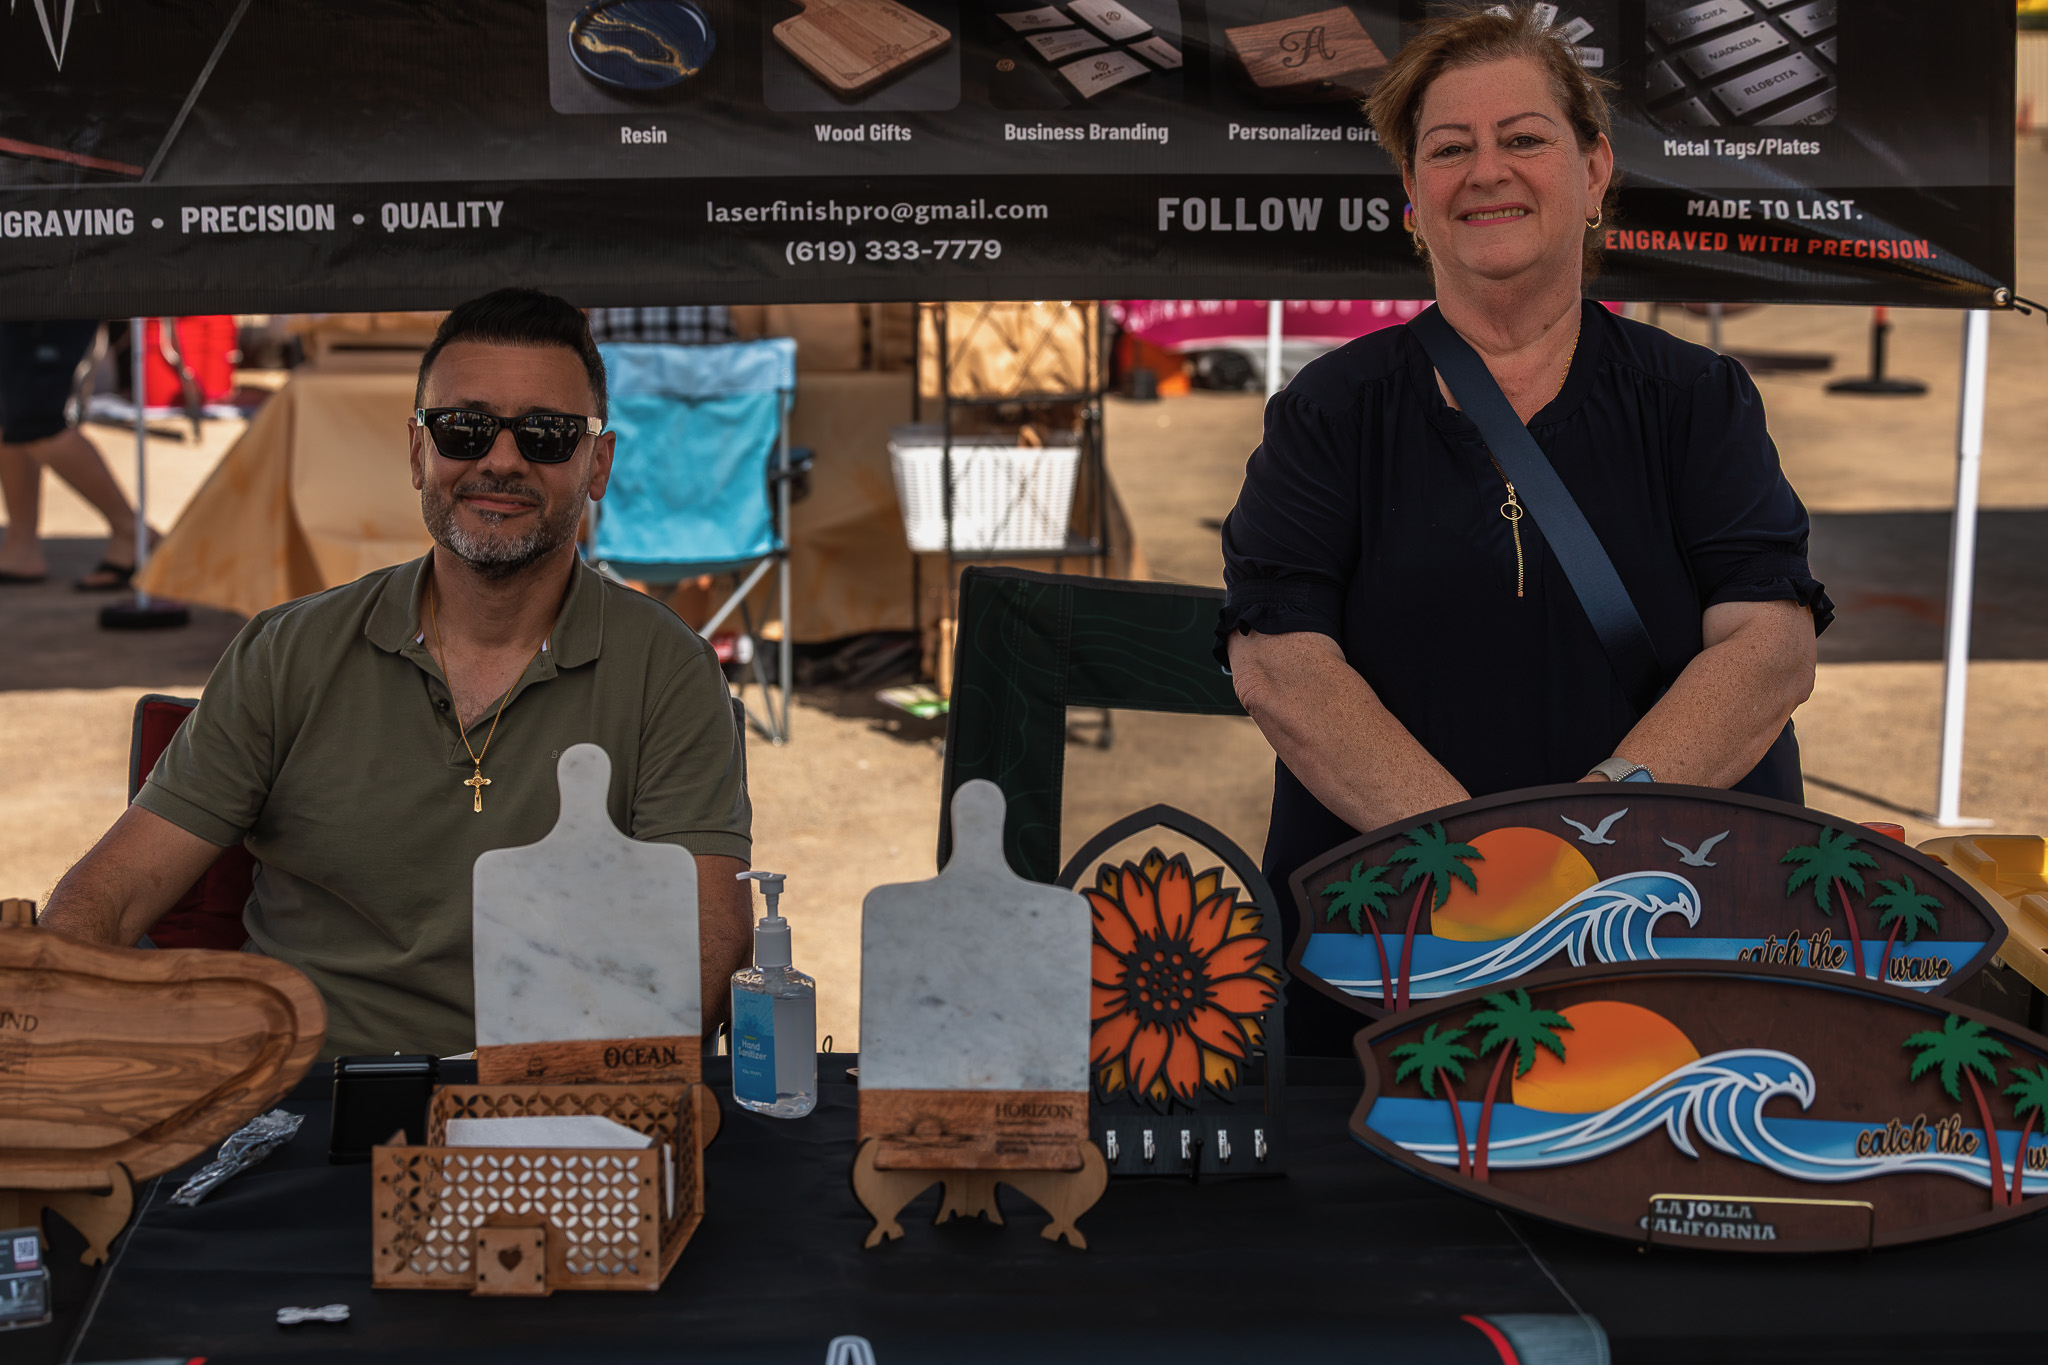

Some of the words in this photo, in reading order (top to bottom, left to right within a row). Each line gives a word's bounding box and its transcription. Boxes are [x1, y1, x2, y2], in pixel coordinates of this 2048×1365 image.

[620, 126, 667, 145] Resin
[814, 124, 865, 142] Wood
[870, 123, 912, 142] Gifts
[1005, 123, 1084, 142] Business
[1089, 123, 1169, 145] Branding
[1229, 123, 1341, 142] Personalized
[1346, 126, 1381, 142] Gift
[1664, 138, 1709, 157] Metal
[1714, 138, 1820, 160] Tags/Plates
[0, 208, 135, 238] GRAVING
[181, 204, 335, 234] PRECISION
[381, 200, 504, 234] QUALITY
[707, 199, 1048, 226] laserfinishpro@gmail.com
[1159, 197, 1321, 232] FOLLOW
[1340, 197, 1390, 232] US
[1686, 199, 1751, 221] MADE
[1762, 200, 1790, 221] TO
[1797, 200, 1863, 221] LAST.
[785, 240, 856, 266] (619)
[865, 239, 1002, 262] 333-7779
[1605, 230, 1728, 252] ENGRAVED
[1739, 235, 1799, 255] WITH
[1808, 239, 1938, 260] PRECISION.
[1808, 927, 1847, 969] the
[1889, 955, 1953, 981] wave
[738, 1047, 767, 1060] Sanitizer
[741, 1040, 760, 1051] Hand
[604, 1045, 683, 1069] OCEAN
[996, 1103, 1073, 1118] HORIZON
[1856, 1113, 1931, 1157] catch
[1935, 1113, 1979, 1155] the
[1655, 1200, 1682, 1215] LA
[1687, 1201, 1752, 1220] JOLLA
